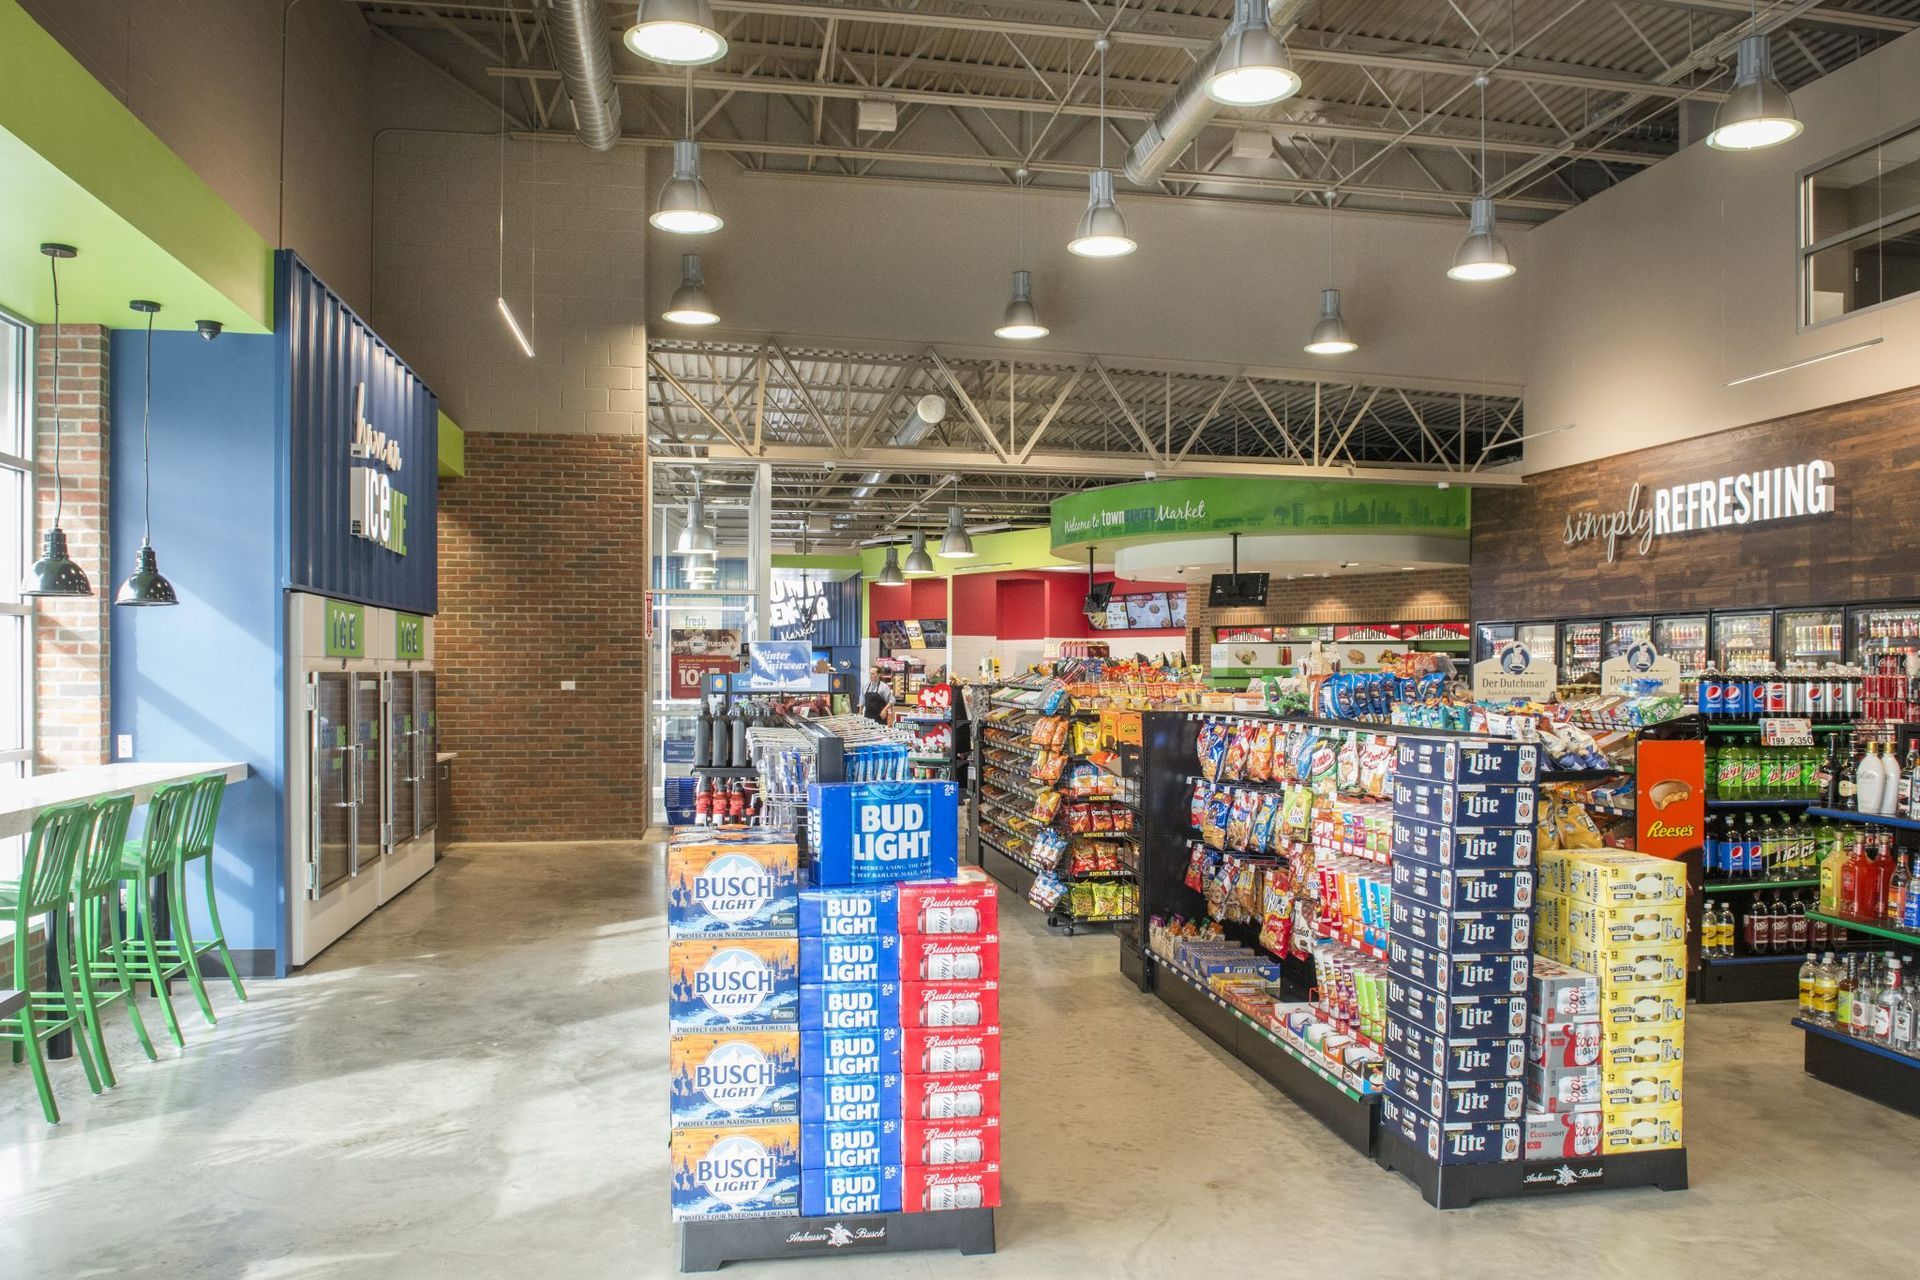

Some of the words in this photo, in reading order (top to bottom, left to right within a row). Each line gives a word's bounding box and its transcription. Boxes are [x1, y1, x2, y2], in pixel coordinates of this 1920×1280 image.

[1064, 516, 1090, 533] Welcome
[1092, 513, 1100, 528] to
[1102, 510, 1124, 526] town
[1155, 500, 1206, 522] Market
[1563, 482, 1655, 563] simply
[1655, 459, 1831, 535] REFRESHING
[686, 616, 706, 626] fresh
[332, 610, 357, 651] ICE
[401, 614, 418, 653] ICE
[1228, 629, 1260, 642] Marlboro
[1348, 626, 1388, 640] Marlboro
[1416, 625, 1460, 640] Marlboro
[1482, 678, 1498, 688] Der
[1500, 678, 1546, 688] Dutchman
[1610, 676, 1626, 686] Der
[1468, 754, 1502, 774] Lite
[1466, 796, 1500, 818] Lite
[862, 804, 924, 832] BUD
[1647, 820, 1695, 838] Reese's
[854, 830, 930, 861] LIGHT
[1464, 838, 1498, 860] Lite
[696, 876, 772, 898] BUSCH
[1464, 882, 1498, 903] Lite
[712, 900, 757, 910] LIGHT
[827, 898, 872, 916] BUD
[919, 896, 980, 908] Budweiser
[822, 917, 877, 934] LIGHT
[1461, 922, 1496, 944] Lite
[829, 945, 874, 963] BUD
[922, 942, 982, 955] Budweiser
[696, 970, 772, 993] BUSCH
[824, 964, 878, 981] LIGHT
[1460, 964, 1494, 987] Lite
[712, 994, 758, 1004] LIGHT
[828, 992, 874, 1010] BUD
[921, 990, 981, 1002] Budweiser
[824, 1010, 878, 1028] LIGHT
[1460, 1008, 1493, 1030] Lite
[830, 1038, 875, 1056] BUD
[923, 1036, 983, 1048] Budweiser
[825, 1056, 880, 1074] LIGHT
[1457, 1050, 1491, 1072] Lite
[697, 1064, 773, 1088] BUSCH
[713, 1087, 758, 1098] LIGHT
[831, 1084, 875, 1104] BUD
[924, 1082, 983, 1094] Budweiser
[1456, 1092, 1489, 1114] Lite
[825, 1103, 880, 1122] LIGHT
[830, 1130, 874, 1150] BUD
[924, 1128, 982, 1140] Budweiser
[1452, 1134, 1486, 1156] Lite
[825, 1148, 880, 1168] LIGHT
[698, 1157, 774, 1181] BUSCH
[714, 1180, 759, 1192] LIGHT
[832, 1176, 876, 1196] BUD
[924, 1173, 982, 1186] Budweiser
[826, 1194, 880, 1214] LIGHT
[786, 1231, 828, 1242] Anheuser
[854, 1227, 885, 1239] Busch
